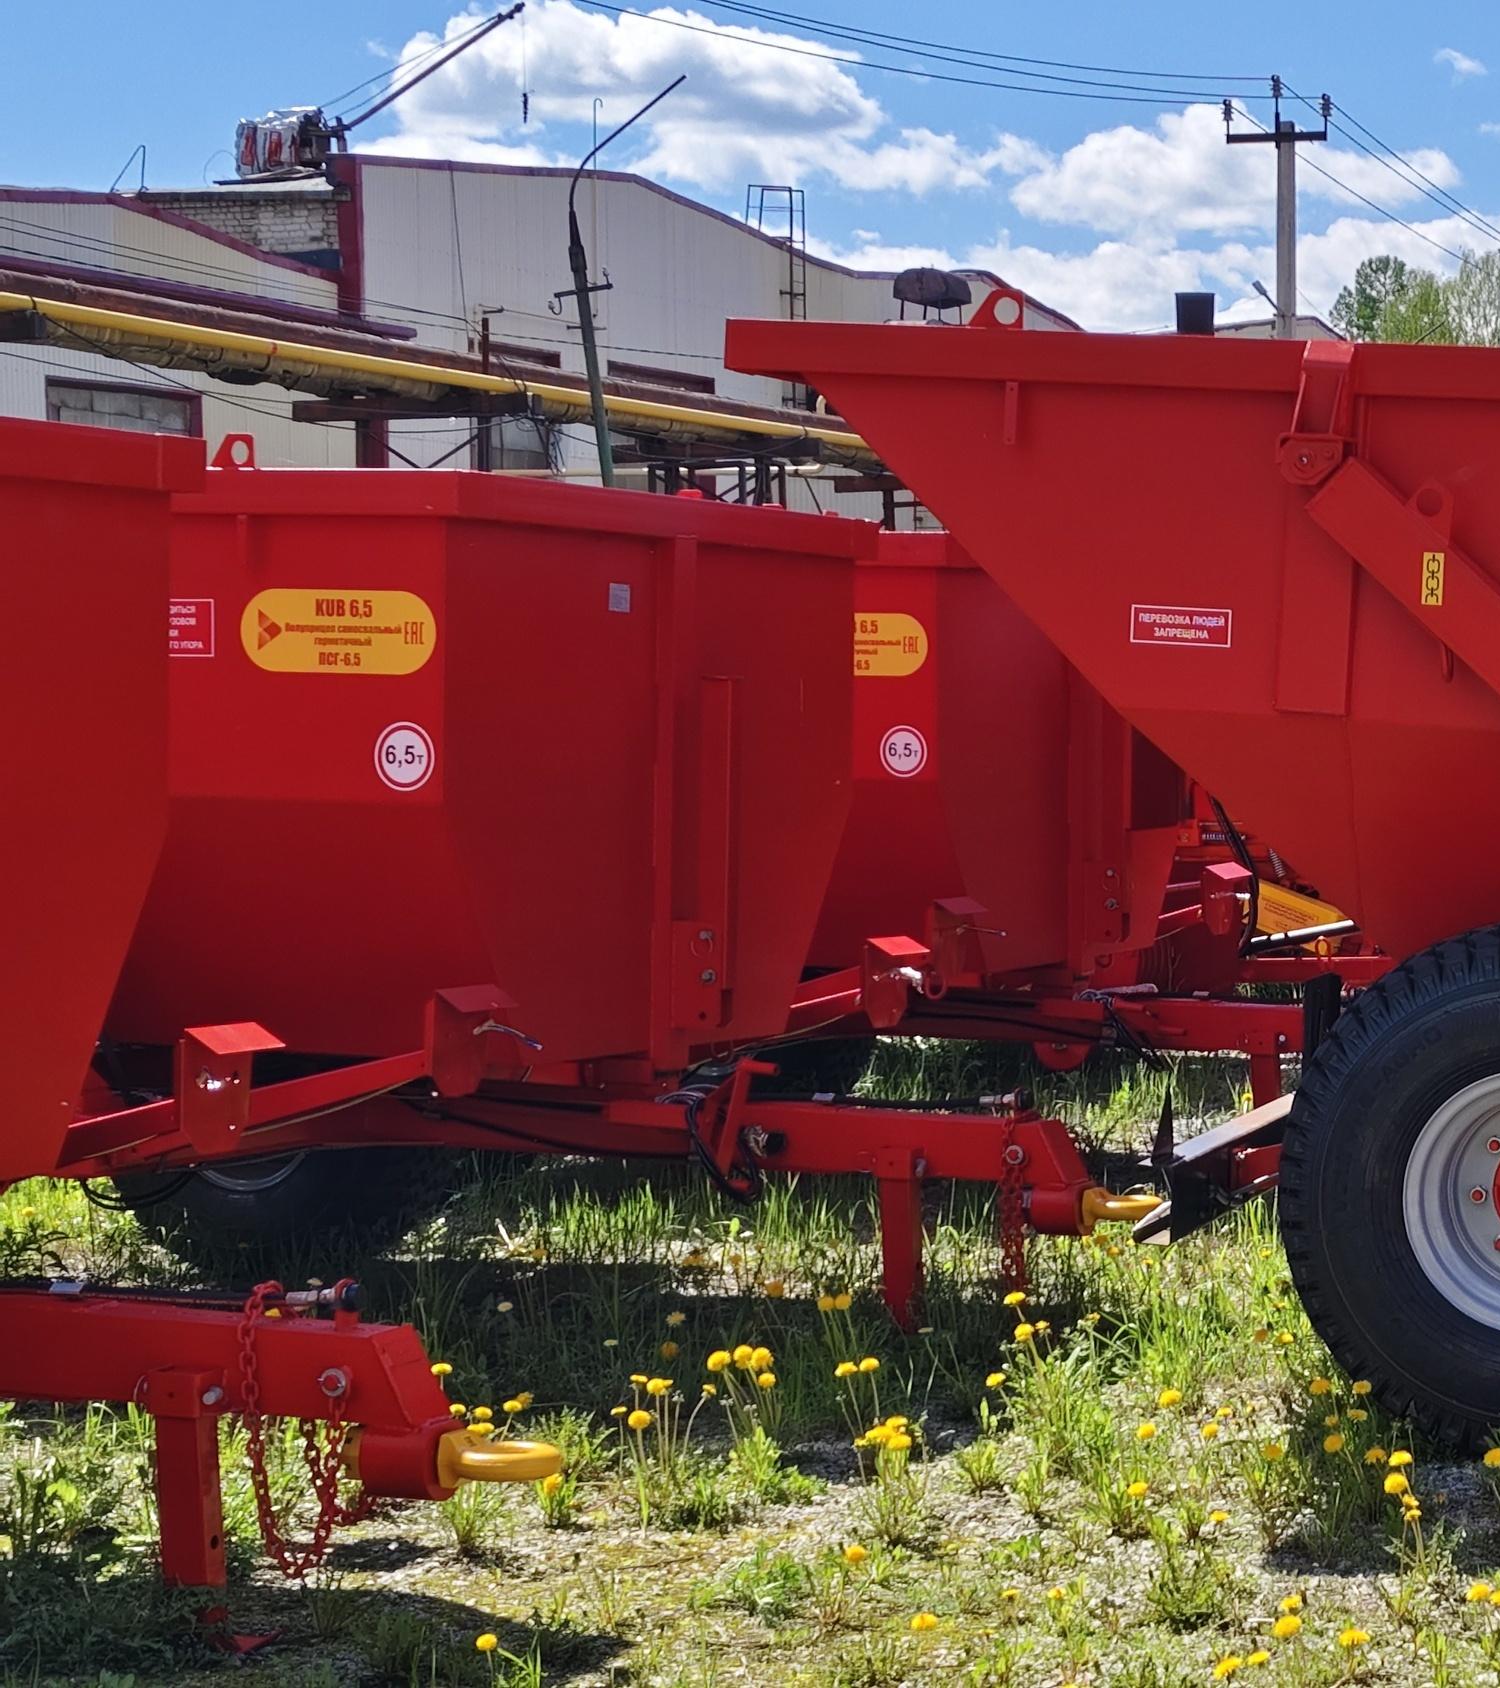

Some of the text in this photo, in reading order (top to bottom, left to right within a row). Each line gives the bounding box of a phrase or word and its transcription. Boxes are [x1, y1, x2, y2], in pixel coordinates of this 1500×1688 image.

[315, 598, 373, 619] KUB 6,5
[1138, 612, 1225, 627] ПЕРЕВОЗКА ЛЮДЕЙ
[1153, 627, 1209, 640] ЗАПРЕЩЕНА
